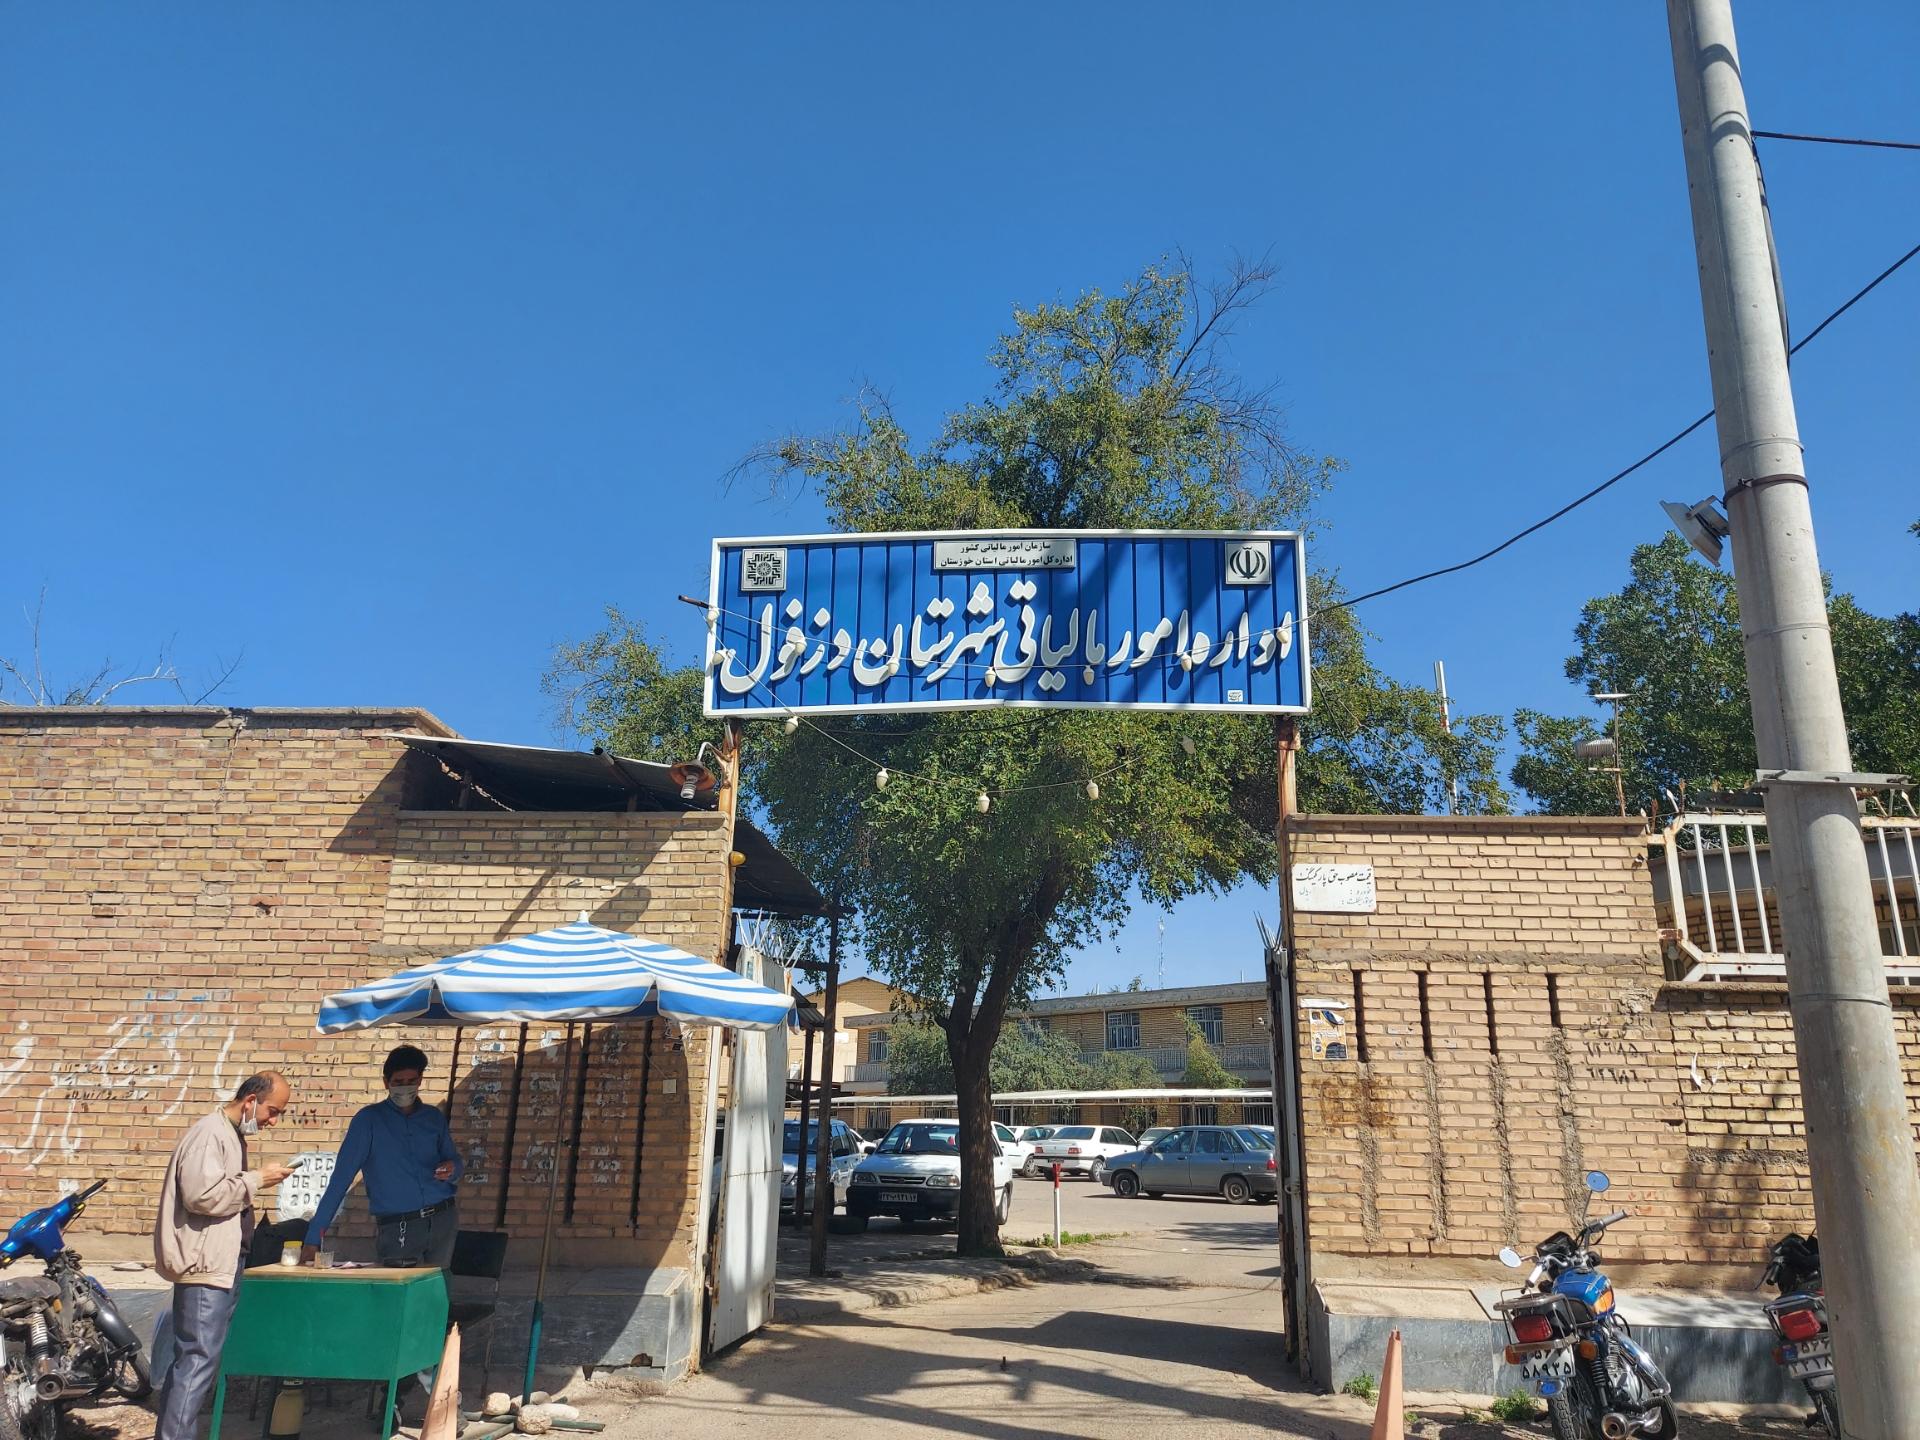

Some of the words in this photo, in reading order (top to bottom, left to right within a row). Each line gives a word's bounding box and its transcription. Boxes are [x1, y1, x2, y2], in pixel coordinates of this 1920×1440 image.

[960, 543, 980, 553] کشور
[980, 541, 1006, 553] مالیاتی
[1007, 542, 1023, 552] امور
[1025, 541, 1051, 551] سازمان
[940, 557, 974, 568] خوزستان
[975, 557, 997, 567] استان
[1028, 556, 1043, 566] امور
[1042, 555, 1054, 566] کل
[1055, 554, 1073, 565] اداره
[852, 582, 1006, 687] شهرستان
[993, 580, 1106, 692] مالیاتی
[1107, 609, 1189, 669] امور
[1191, 611, 1292, 668] اداره
[719, 597, 852, 694] دزفول
[1356, 868, 1372, 885] قیمت
[1522, 1361, 1572, 1379] ۵۸۹۳۵
